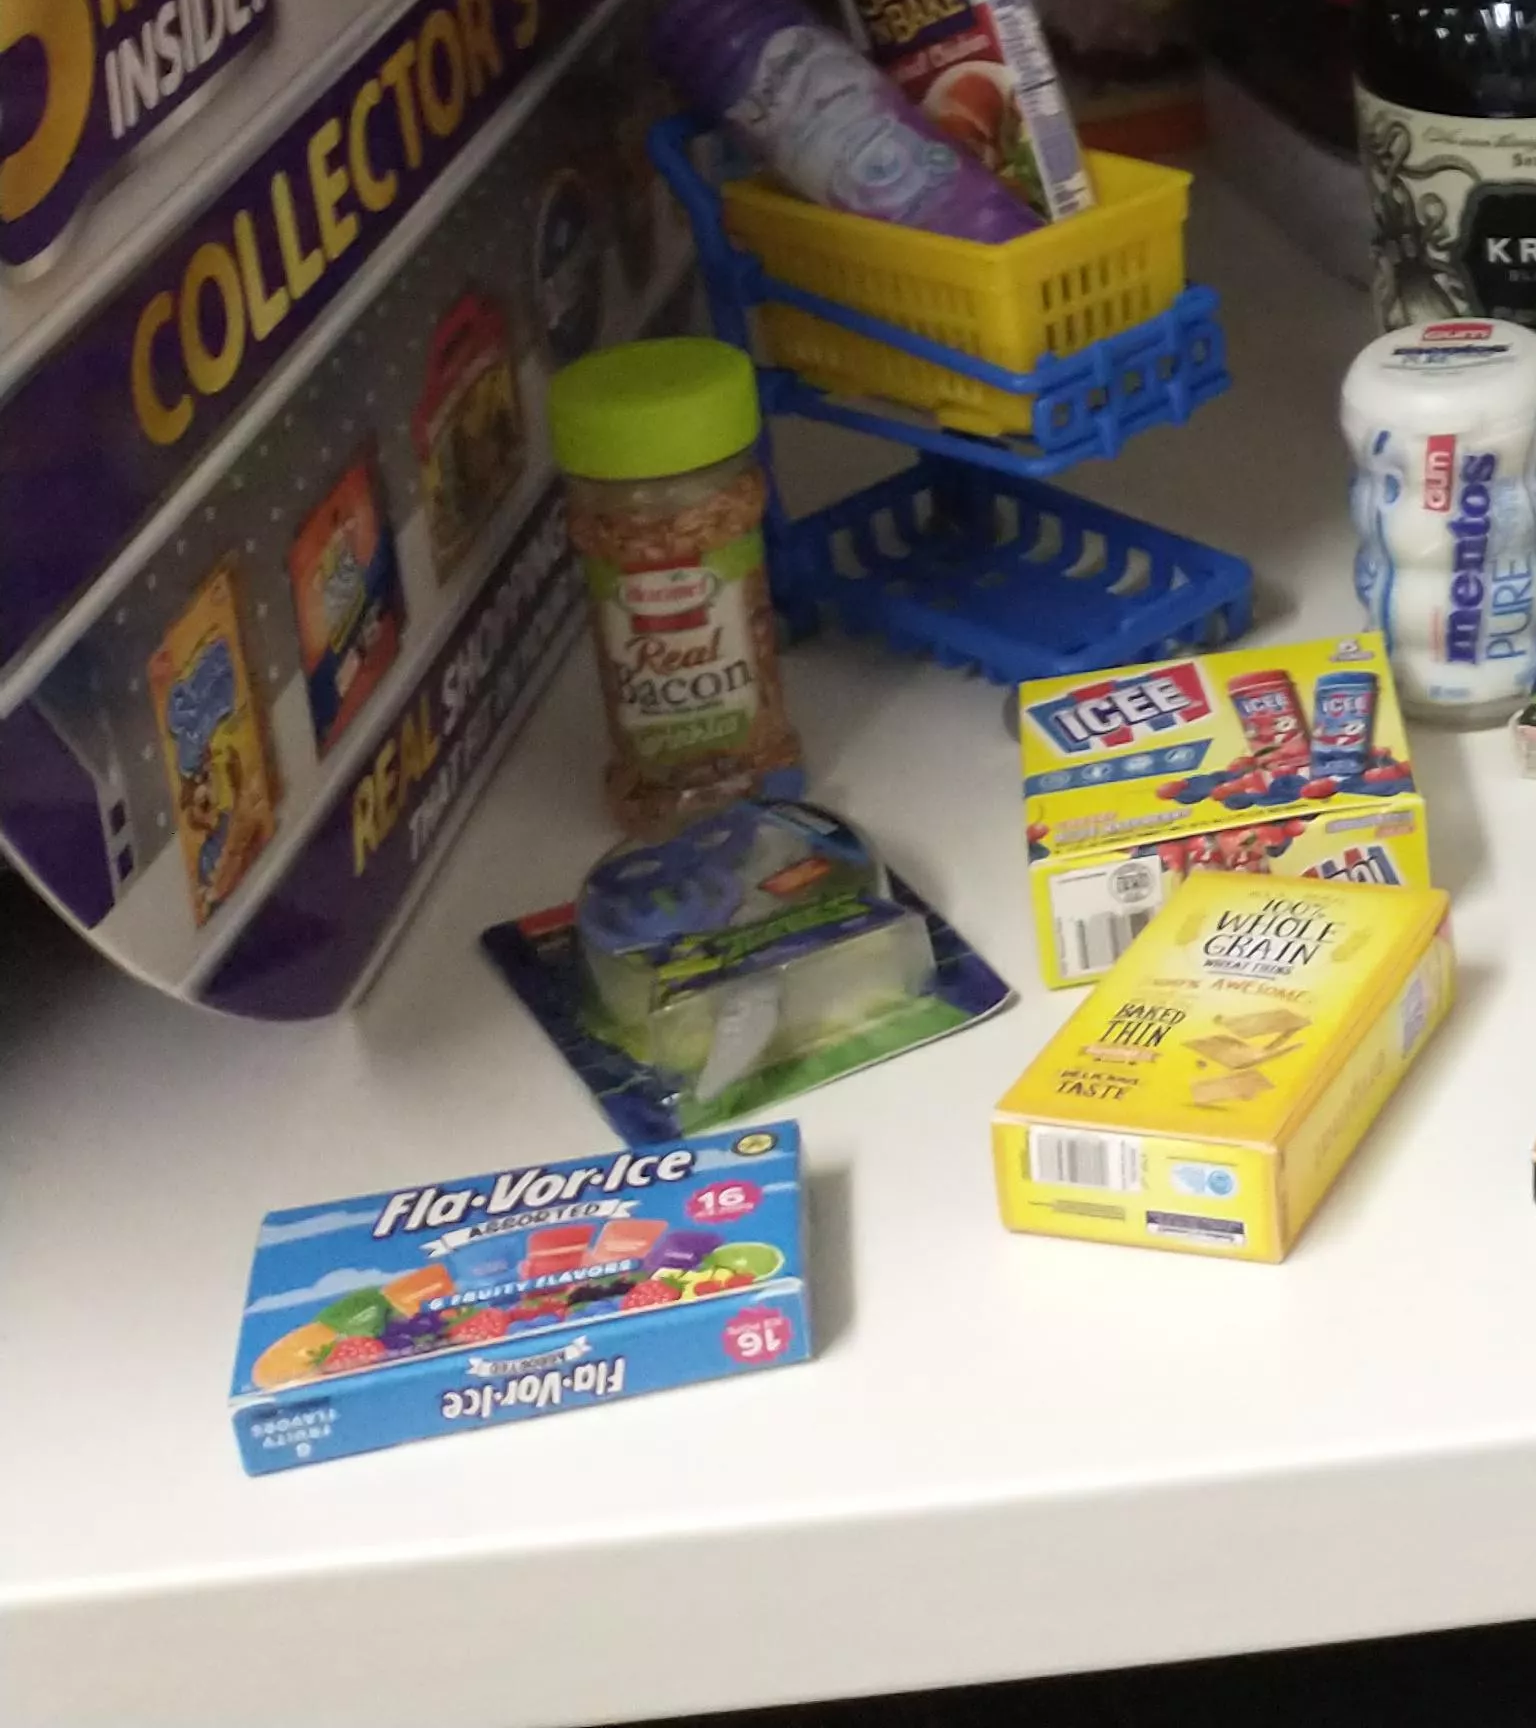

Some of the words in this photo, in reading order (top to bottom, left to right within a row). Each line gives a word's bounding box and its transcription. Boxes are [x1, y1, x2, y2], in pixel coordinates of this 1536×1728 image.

[1446, 453, 1496, 665] mentos
[626, 627, 723, 672] Real
[1055, 675, 1193, 743] ICEE
[1241, 692, 1291, 716] ICEE
[1321, 693, 1368, 716] ICEE
[1215, 909, 1342, 944] WHOLE
[1202, 933, 1320, 966] GRAIN
[1114, 1001, 1187, 1025] BAKED
[1099, 1019, 1172, 1048] THIN
[696, 1185, 747, 1214] 16
[468, 1202, 600, 1239] ASSORTED
[428, 1295, 446, 1311] 6
[447, 1278, 536, 1308] FRUITY
[536, 1259, 634, 1291] FLAVORS
[738, 1330, 781, 1359] 16
